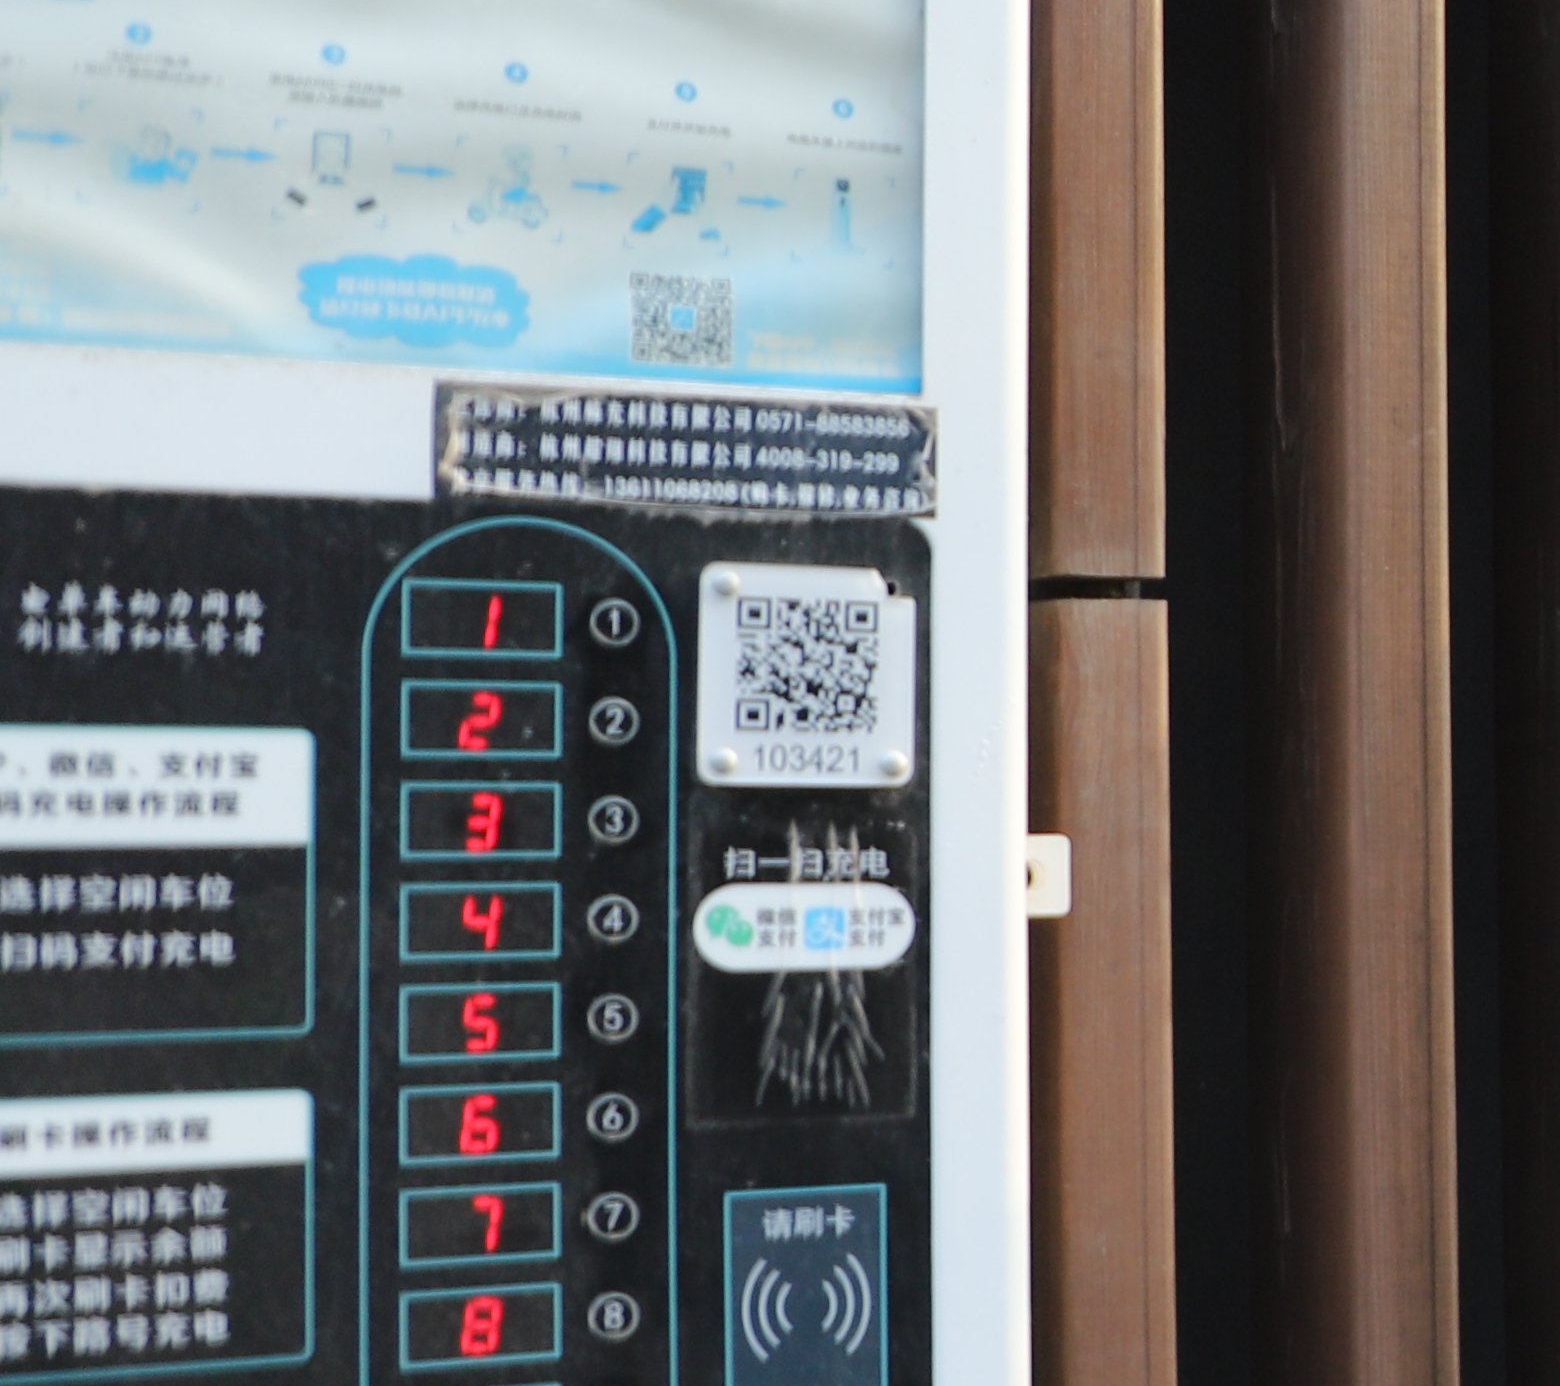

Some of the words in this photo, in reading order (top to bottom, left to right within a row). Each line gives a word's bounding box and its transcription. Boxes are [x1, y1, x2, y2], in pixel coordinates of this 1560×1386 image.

[481, 594, 503, 651] 1
[458, 691, 503, 752] 2
[753, 744, 861, 773] 103421
[466, 791, 504, 855] 3
[723, 845, 890, 880] 扫一扫充电
[461, 894, 503, 952] 4
[462, 991, 501, 1056] 5
[458, 1093, 501, 1156] 6
[470, 1195, 502, 1255] 7
[763, 1206, 854, 1242] 请刷卡
[459, 1295, 503, 1357] 8
